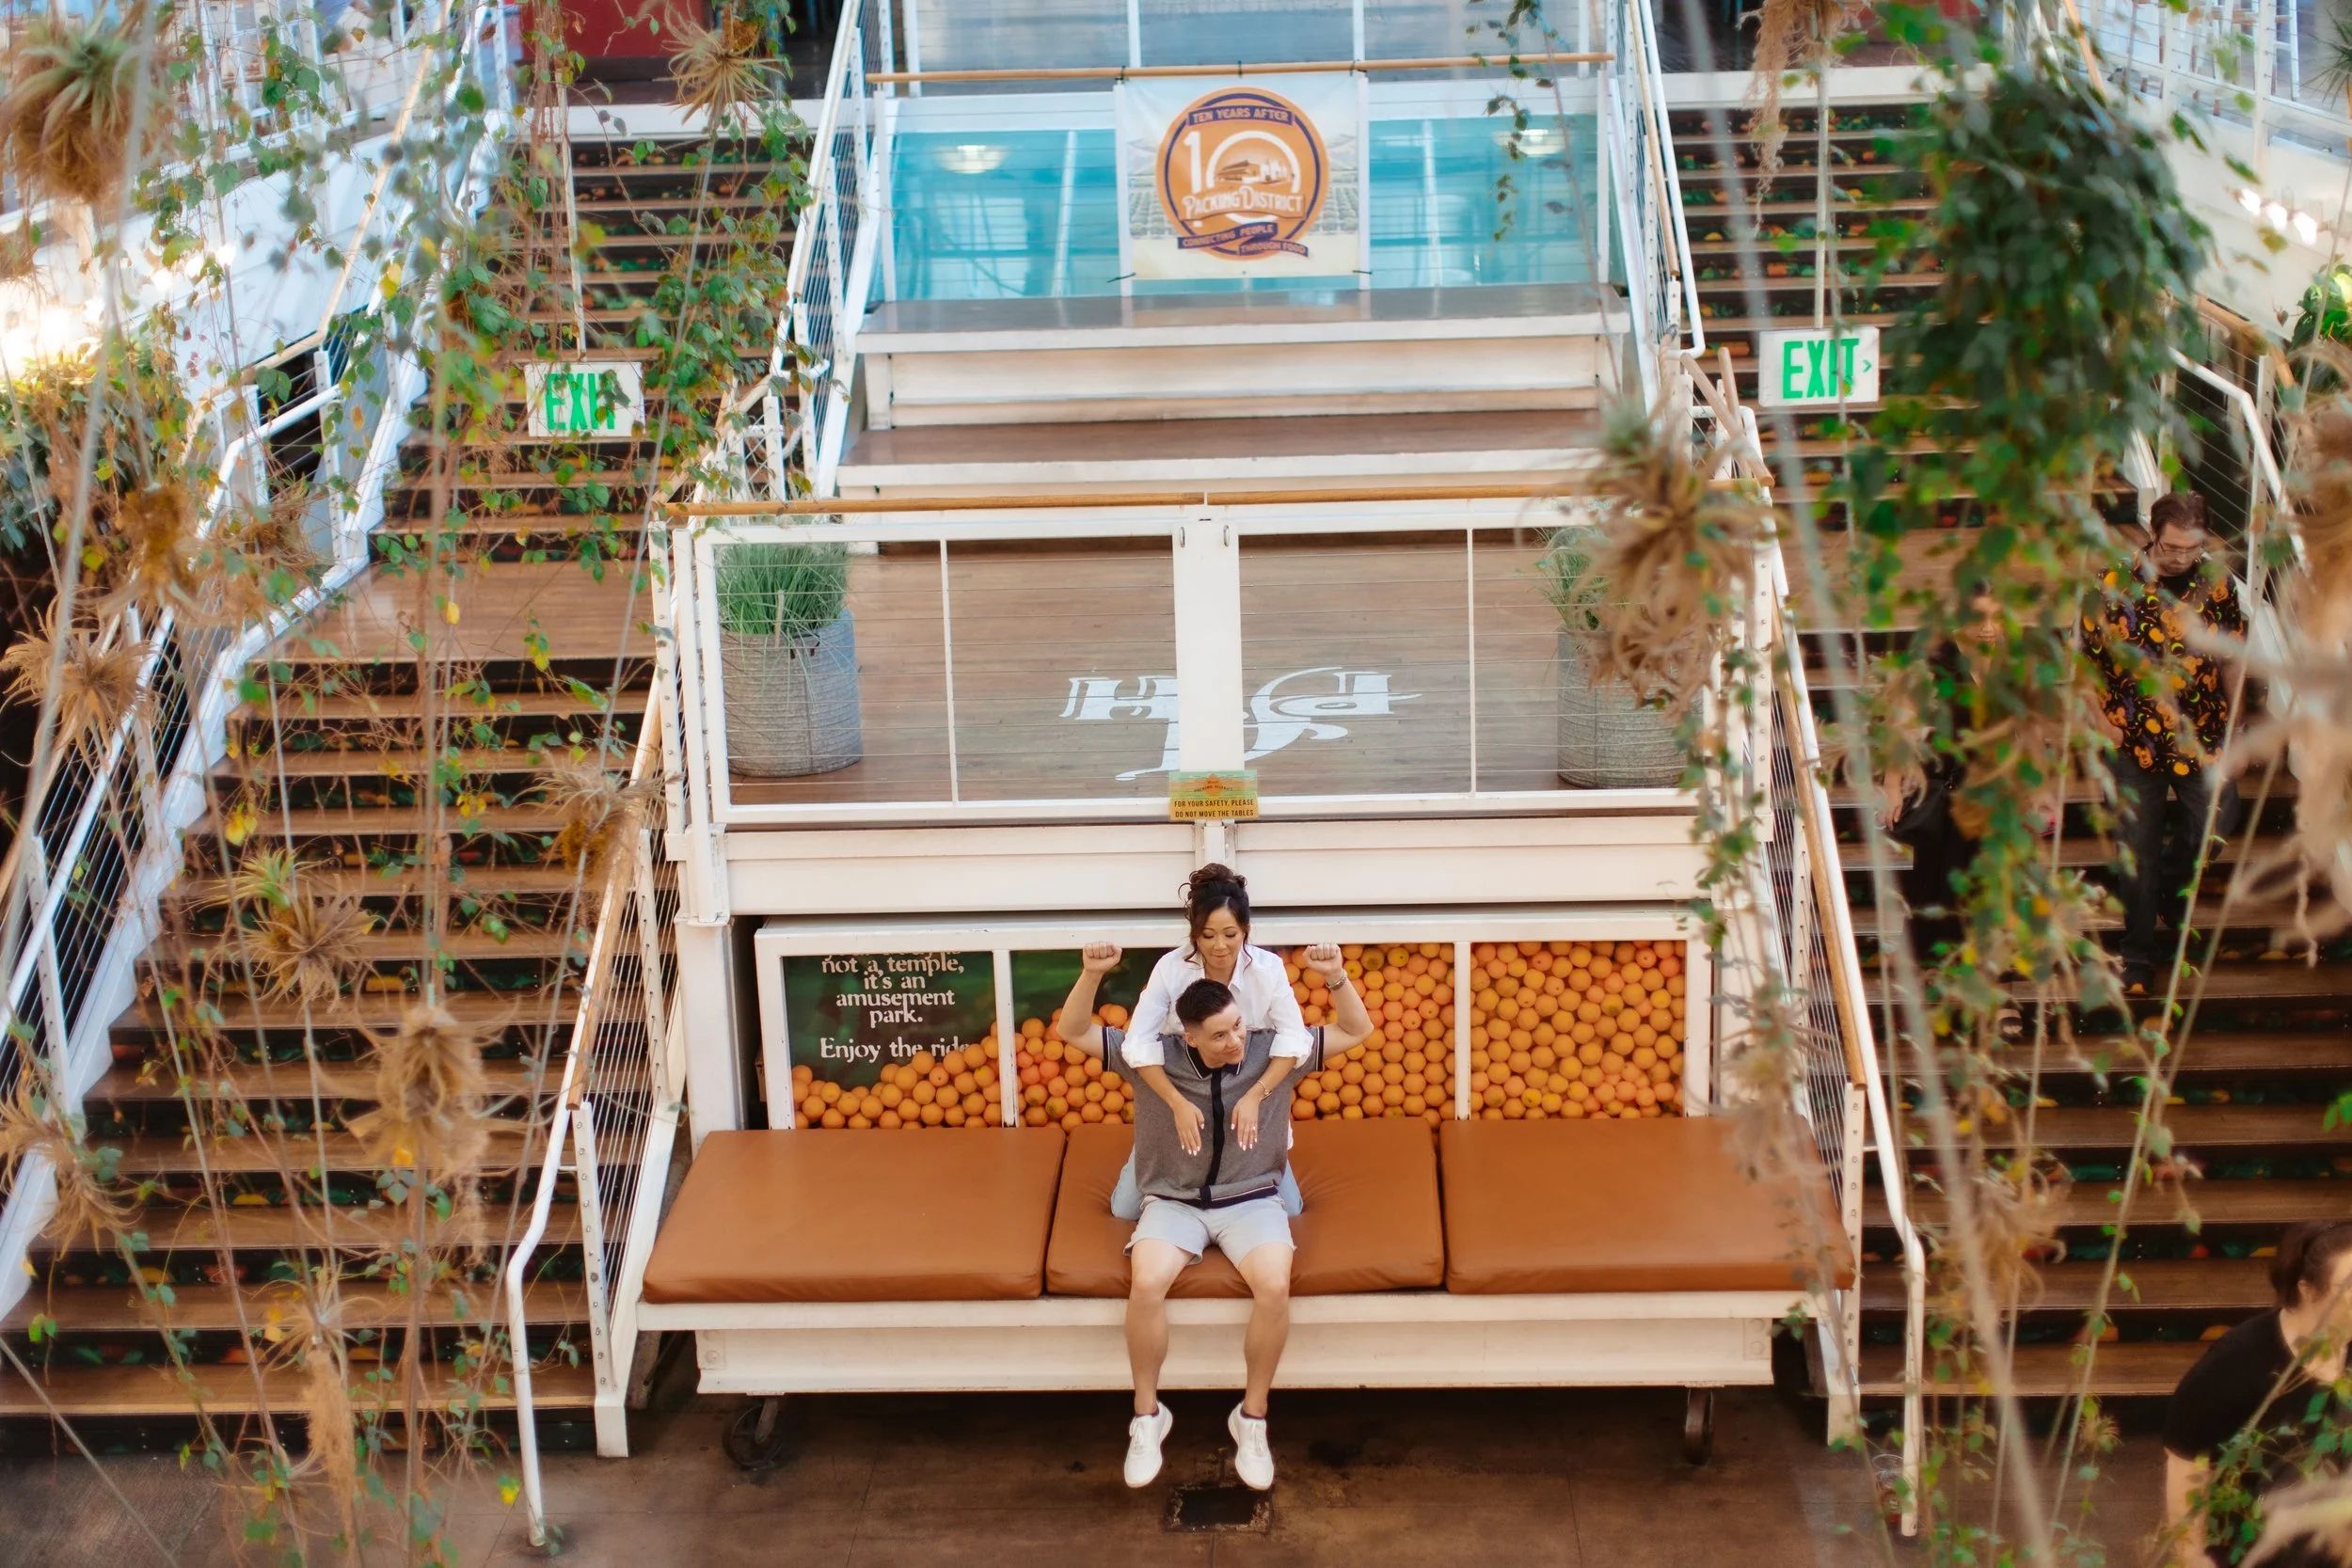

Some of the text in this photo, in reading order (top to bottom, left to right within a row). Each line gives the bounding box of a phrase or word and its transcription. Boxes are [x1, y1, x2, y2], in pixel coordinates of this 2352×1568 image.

[1192, 107, 1289, 123] TEN YEARS AFTER
[1239, 223, 1275, 237] PEOPLE
[1782, 338, 1860, 399] EXIT
[821, 957, 859, 974] not
[886, 952, 964, 977] temple,
[864, 968, 926, 990] it's an
[835, 990, 956, 1007] amusement
[869, 1000, 924, 1028] park.
[820, 1037, 882, 1063] Enjoy
[889, 1036, 924, 1057] the
